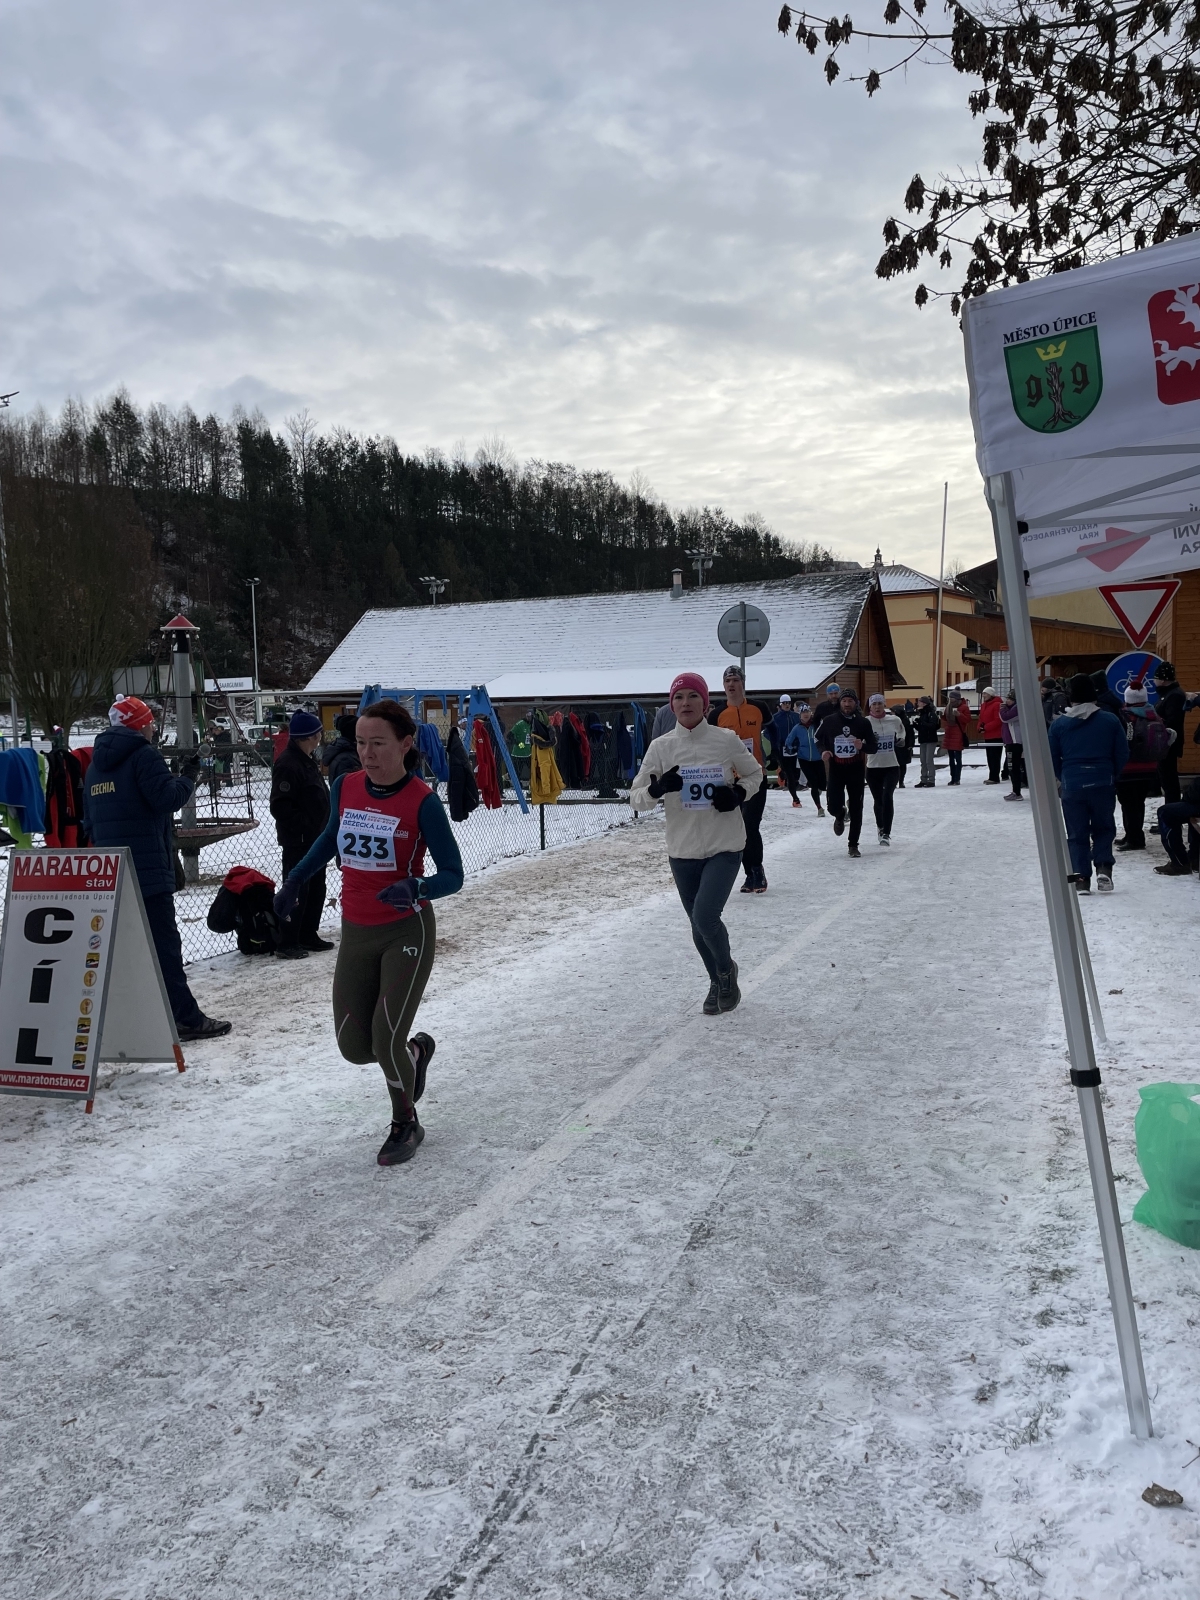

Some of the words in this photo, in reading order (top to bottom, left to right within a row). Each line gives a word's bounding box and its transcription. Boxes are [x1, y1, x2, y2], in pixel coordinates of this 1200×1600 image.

[1003, 323, 1050, 344] MĚSTO
[1052, 311, 1097, 332] ÚPICE
[836, 745, 856, 754] 242
[877, 741, 893, 750] 288
[90, 781, 116, 797] CZECHIA
[689, 783, 717, 801] 90
[344, 811, 368, 821] ZIMNÍ
[375, 824, 393, 832] LIGA
[342, 832, 389, 860] 233
[14, 855, 120, 876] MARATON
[85, 878, 114, 888] stav
[61, 892, 90, 902] jednota
[93, 892, 115, 901] Úpice
[15, 907, 75, 1066] CÍL
